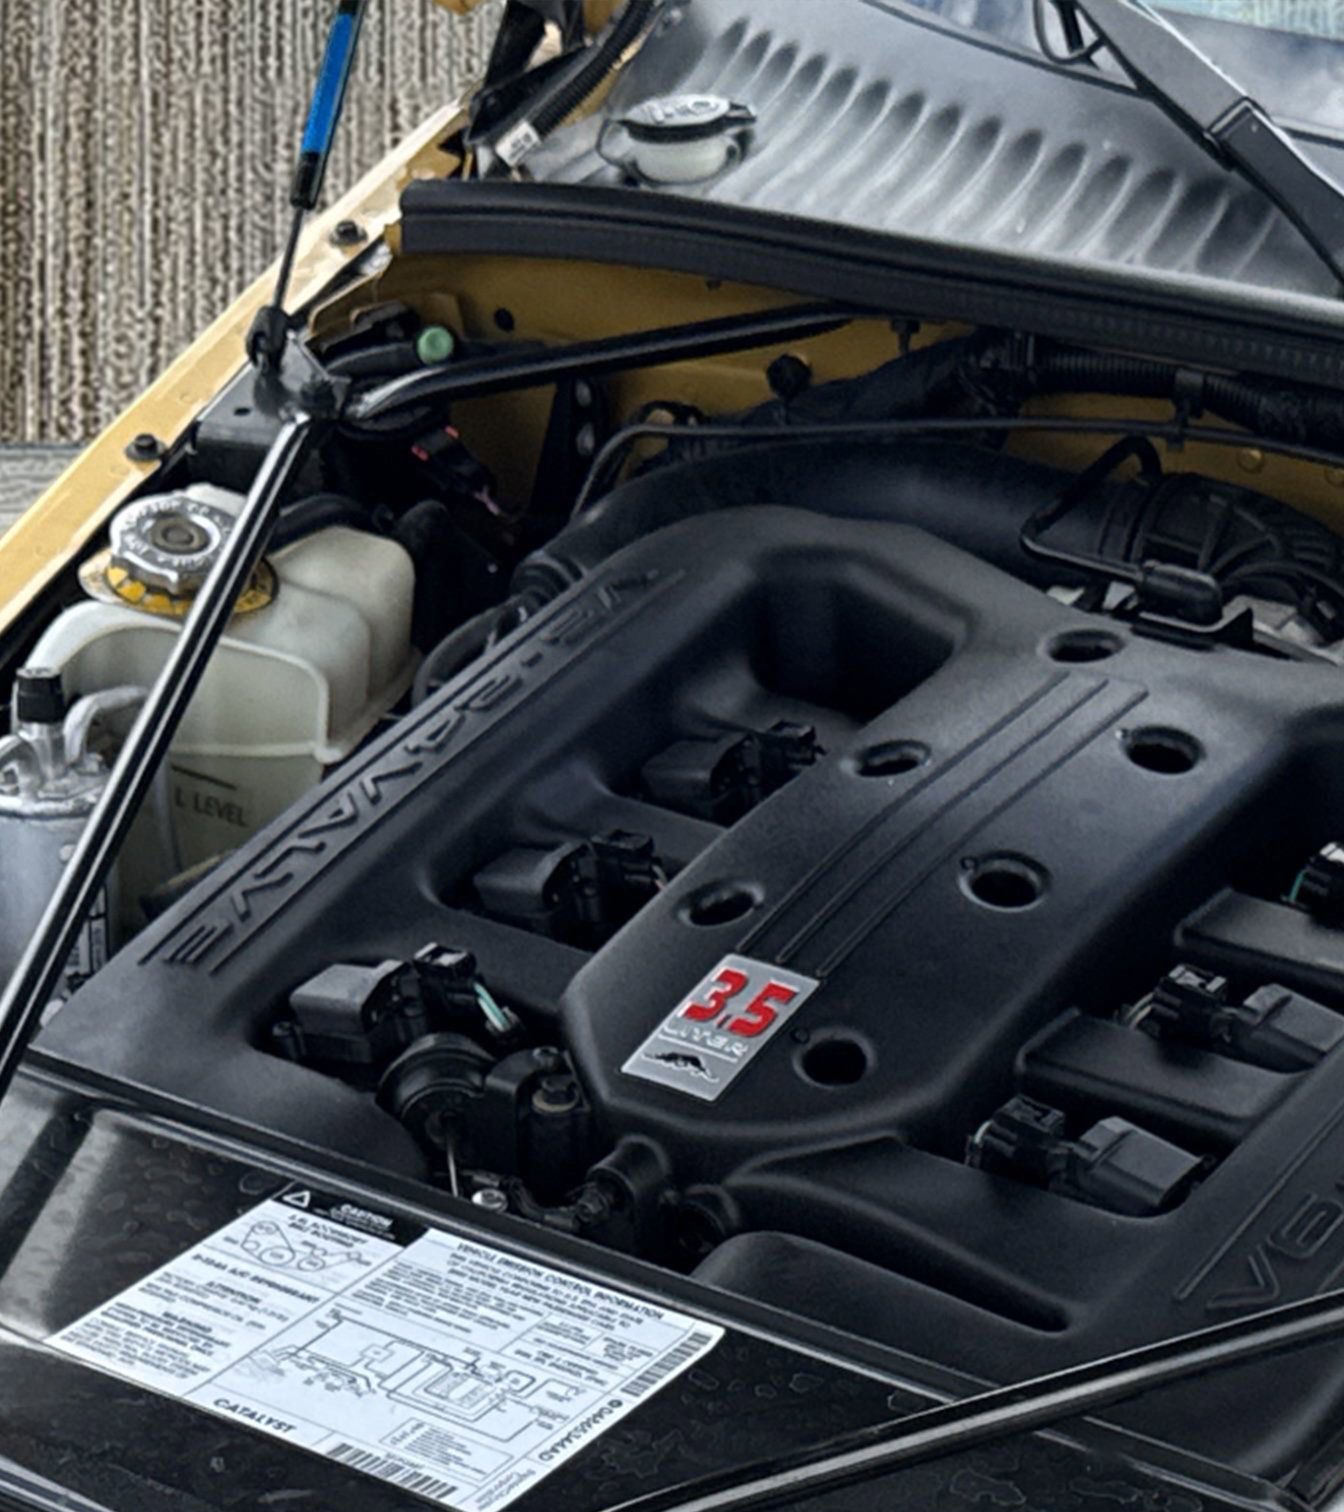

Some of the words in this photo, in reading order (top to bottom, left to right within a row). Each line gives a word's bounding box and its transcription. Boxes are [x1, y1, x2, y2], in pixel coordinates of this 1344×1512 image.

[193, 791, 249, 829] LEVEL
[676, 966, 801, 1038] 3.5
[661, 1023, 749, 1057] LITER
[213, 1398, 297, 1434] CATALYST
